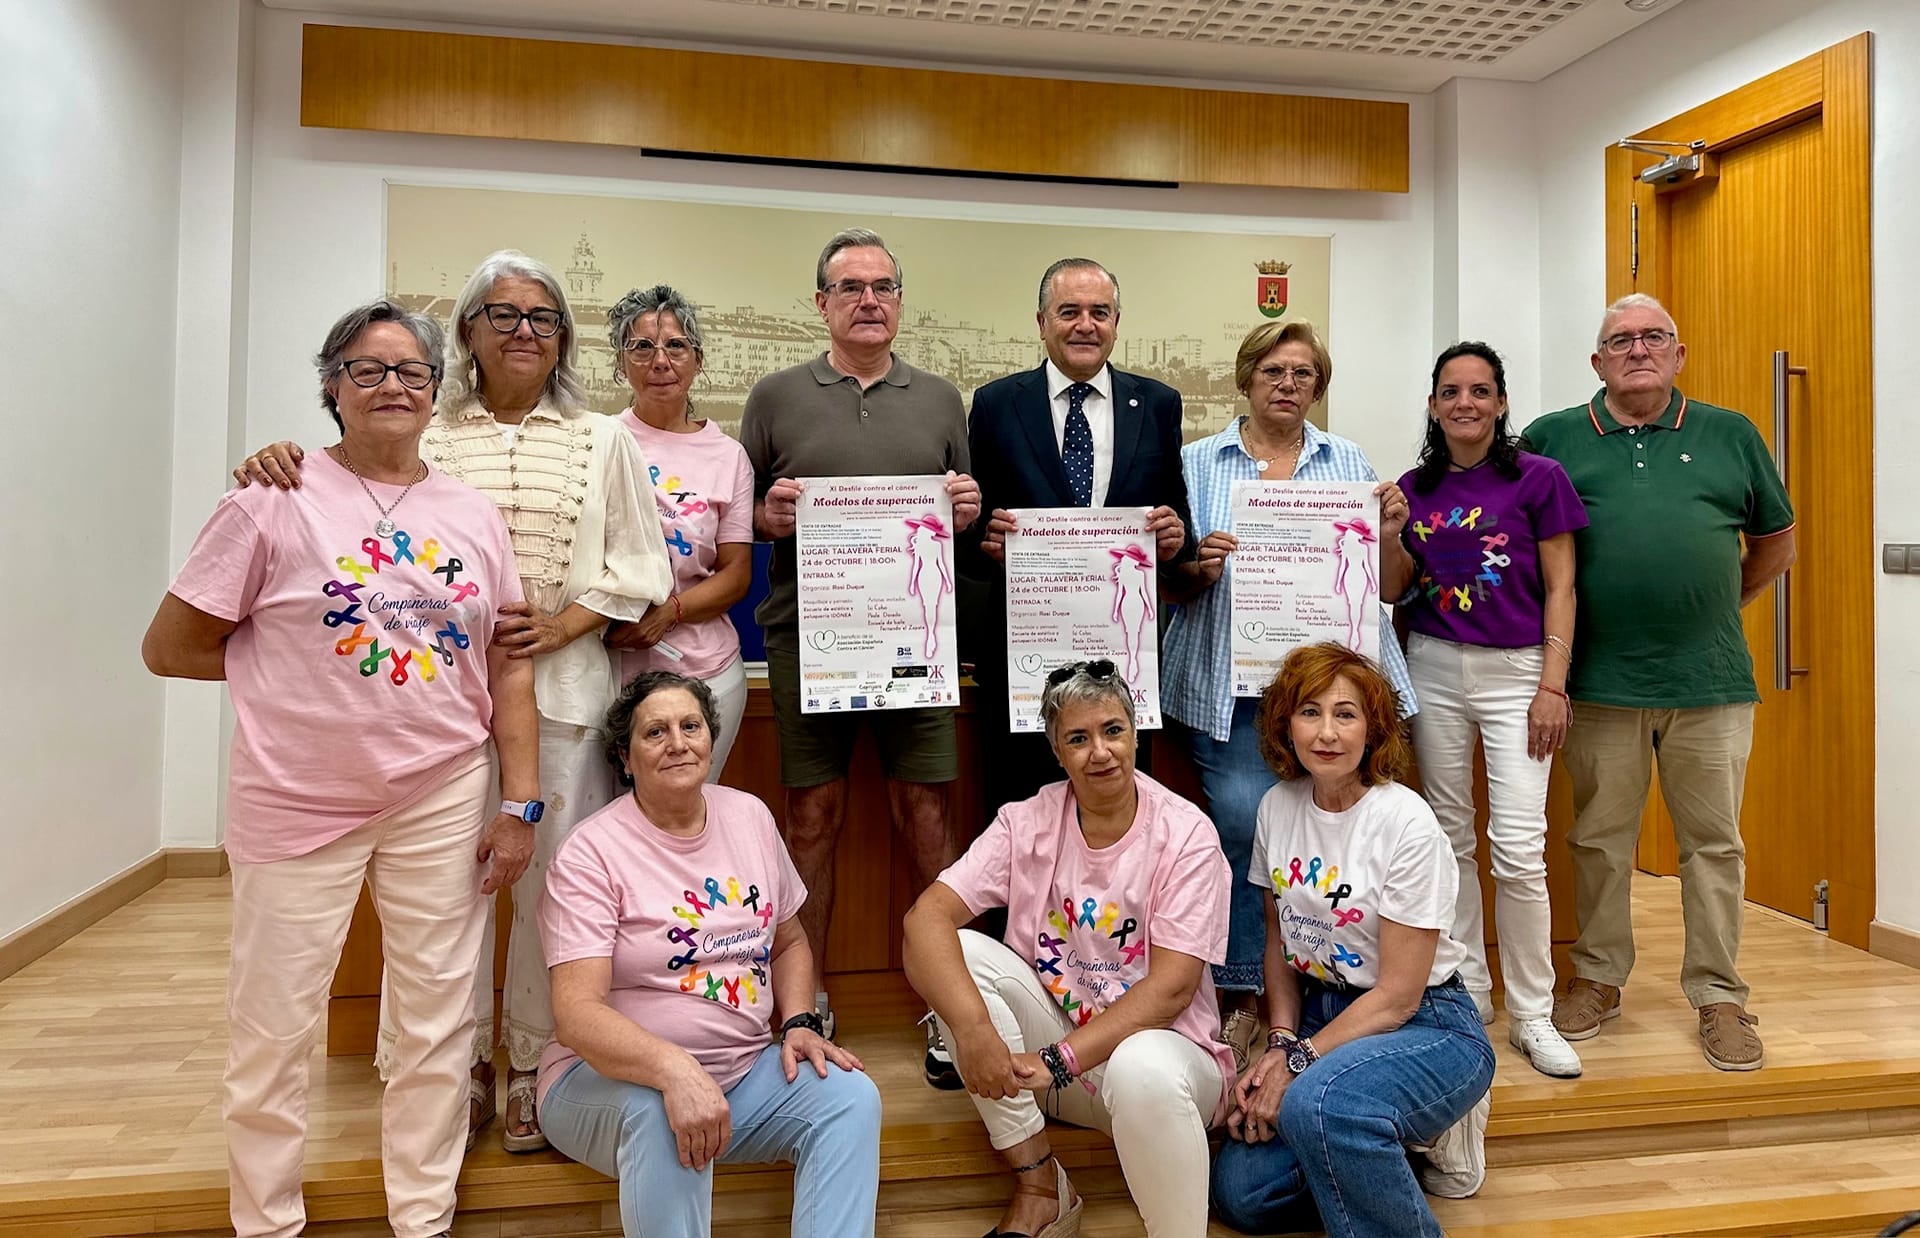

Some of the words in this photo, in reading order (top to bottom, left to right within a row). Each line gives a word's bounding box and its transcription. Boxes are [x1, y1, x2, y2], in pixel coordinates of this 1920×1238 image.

[813, 496, 860, 507] Modelos
[862, 496, 874, 506] de
[876, 494, 935, 508] superación
[1248, 498, 1292, 508] Modelos
[1294, 498, 1306, 508] de
[1307, 499, 1364, 511] superación
[1022, 528, 1066, 537] Modelos
[1068, 527, 1080, 536] de
[1082, 525, 1138, 538] superación
[832, 547, 874, 555] TALAVERA
[846, 584, 865, 592] Duque
[368, 592, 450, 616] Compañeras
[384, 614, 402, 630] de
[406, 616, 431, 636] viaje
[1281, 904, 1333, 932] Compañeras
[703, 927, 761, 954] Compañeras
[1291, 927, 1302, 940] de
[1302, 932, 1326, 952] viaje
[731, 946, 754, 966] viaje
